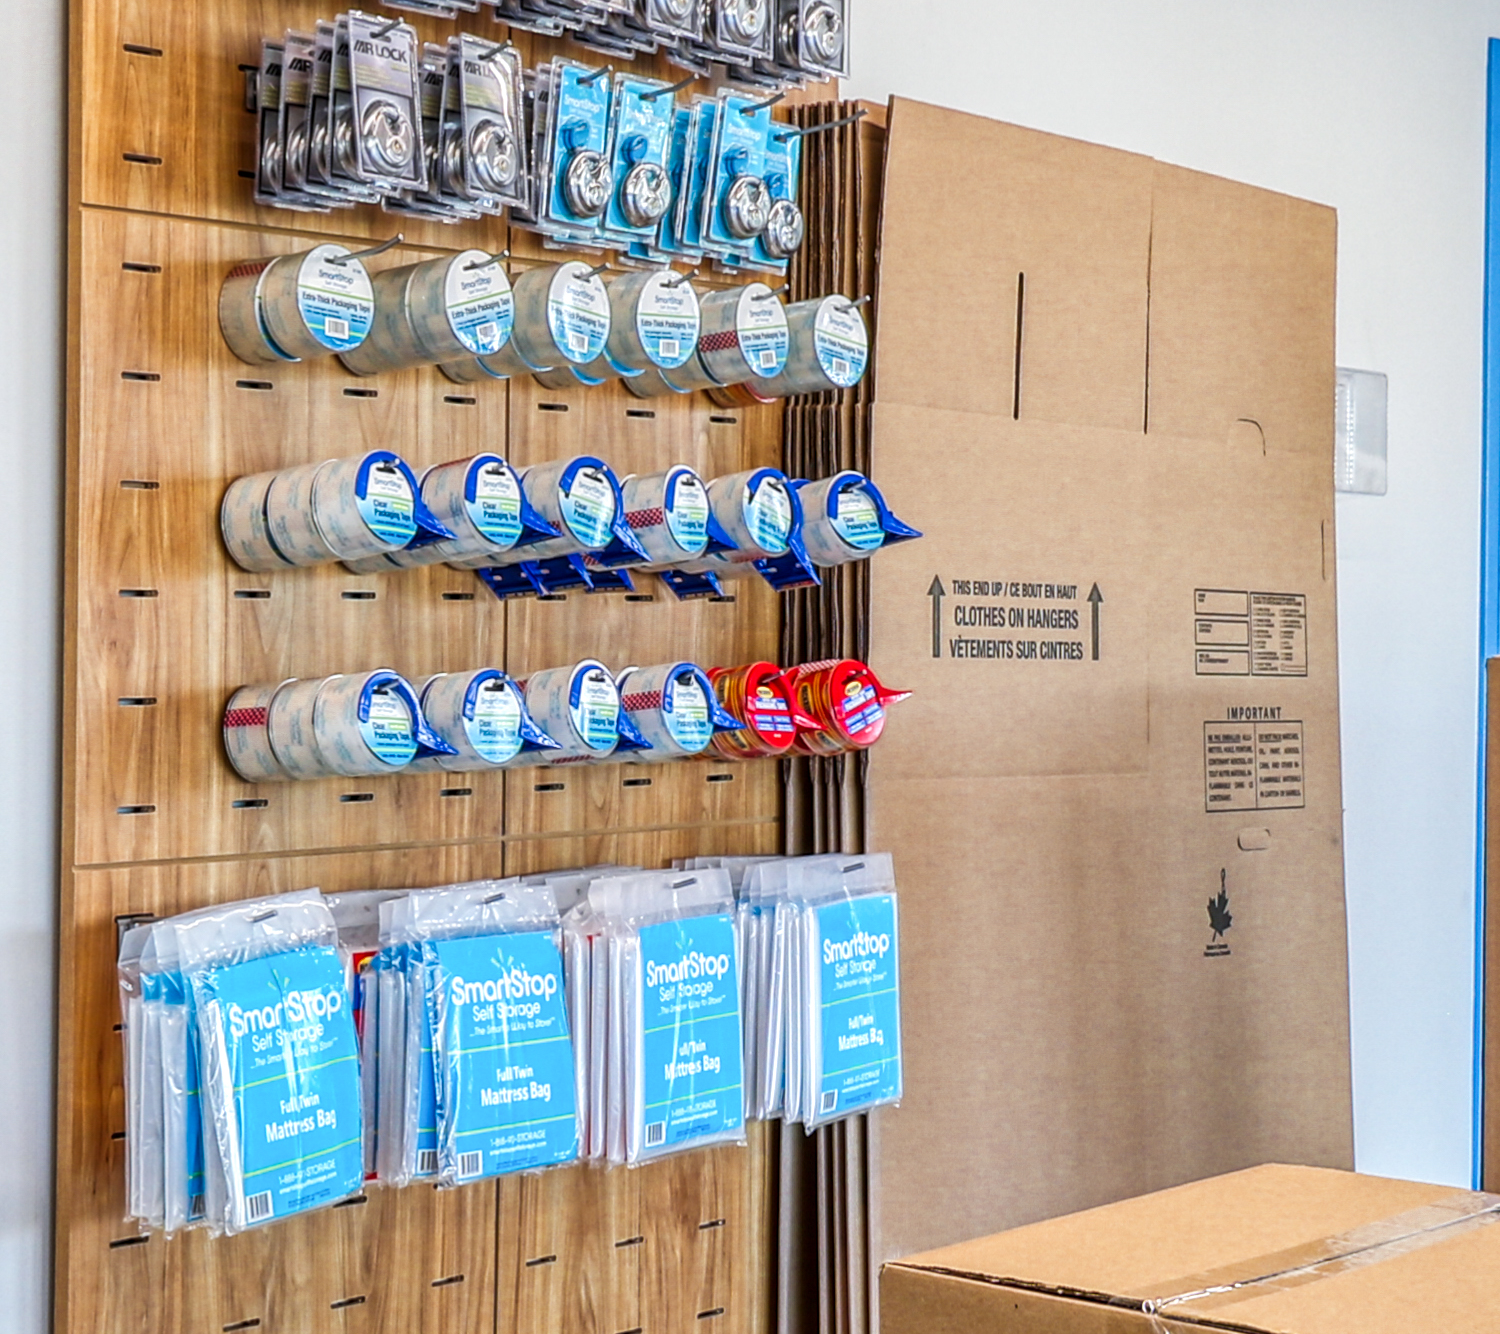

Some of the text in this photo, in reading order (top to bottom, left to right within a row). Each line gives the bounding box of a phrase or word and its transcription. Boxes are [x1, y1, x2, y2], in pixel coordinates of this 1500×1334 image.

[953, 580, 971, 595] THIS
[973, 581, 989, 596] END
[992, 582, 1002, 595] UP
[1010, 583, 1019, 597] CE
[1022, 583, 1042, 598] BOUT
[1045, 584, 1055, 598] EN
[1057, 585, 1077, 599] HAUT
[955, 606, 1078, 629] CLOTHES ON HANGERS
[1016, 640, 1037, 659] SUR
[1040, 642, 1083, 660] CINTRES
[1227, 707, 1281, 719] IMPORTANT
[823, 932, 890, 964] SmartStop
[452, 969, 557, 1005] SmartStop
[473, 1005, 494, 1021] Self
[481, 1081, 551, 1107] Mattress Bag
